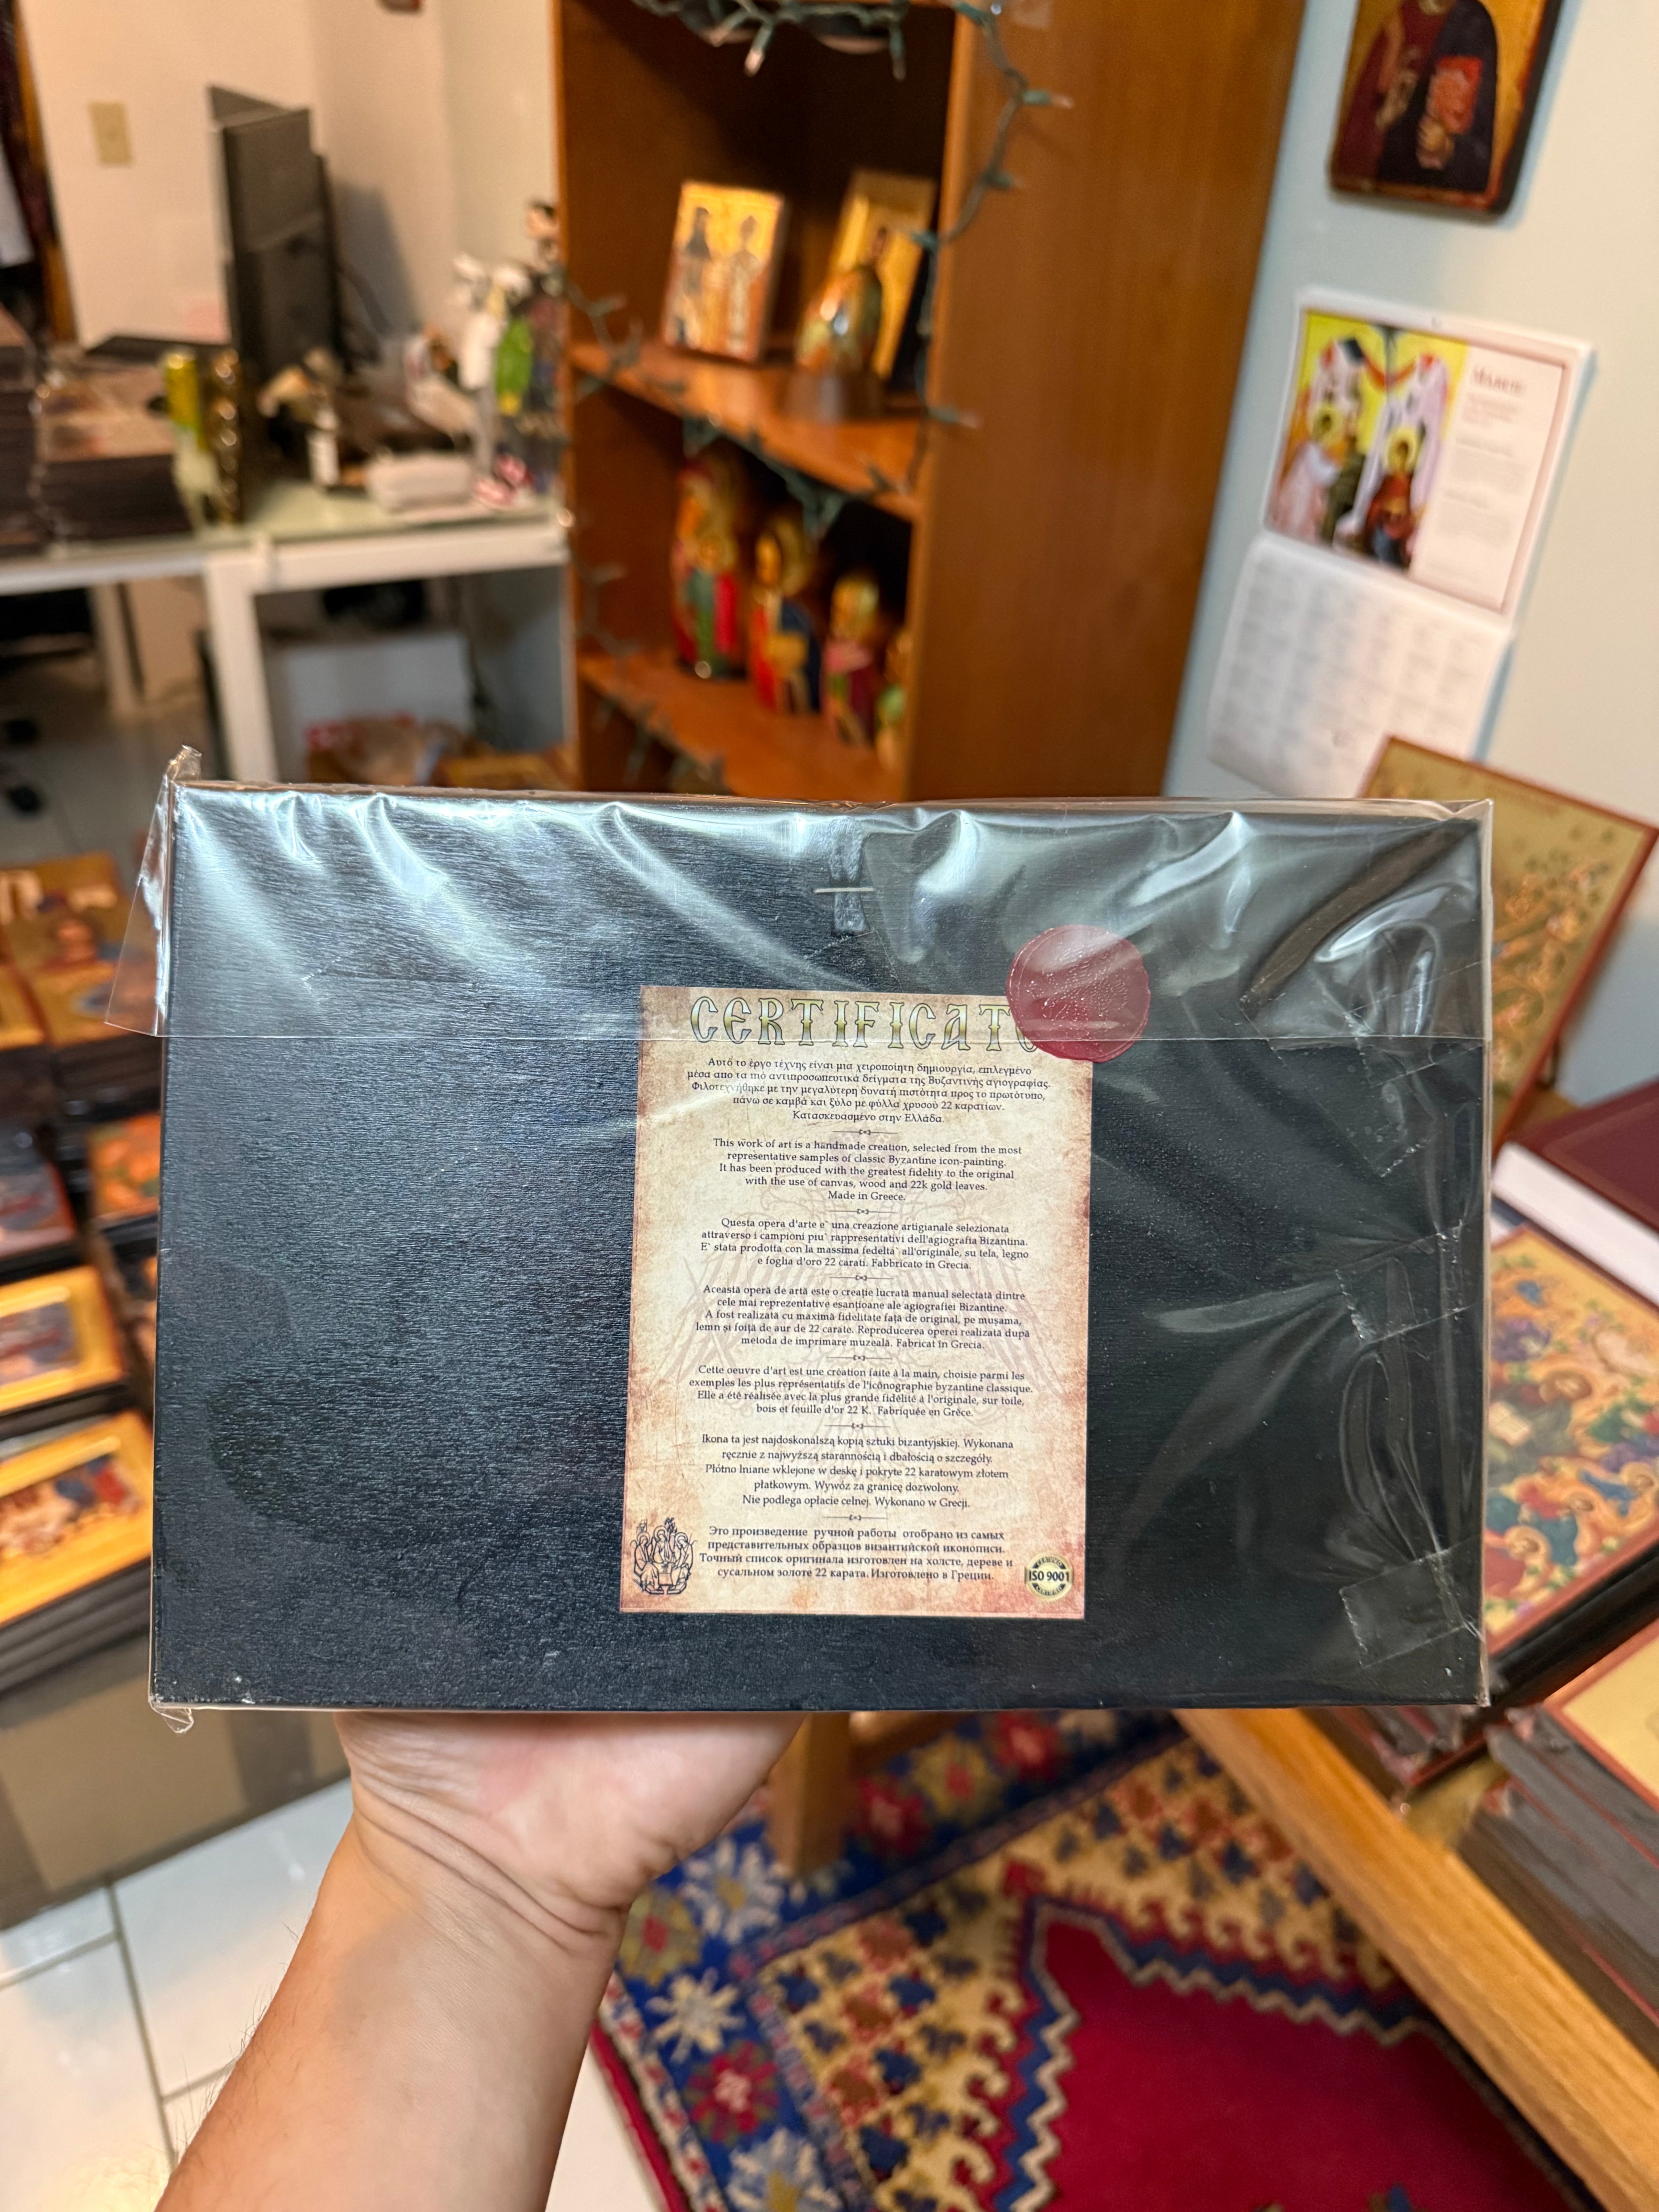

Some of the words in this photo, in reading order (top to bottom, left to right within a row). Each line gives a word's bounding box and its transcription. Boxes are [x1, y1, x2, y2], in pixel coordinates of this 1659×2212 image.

[690, 996, 1038, 1052] CERTIFICAT
[855, 1101, 867, 1109] με
[941, 1100, 952, 1109] 22
[954, 1100, 1005, 1113] καρατίων.
[878, 1115, 902, 1124] στην
[713, 1137, 734, 1147] This
[737, 1138, 763, 1147] work
[765, 1138, 775, 1148] of
[778, 1140, 792, 1148] art
[795, 1140, 803, 1149] is
[812, 1140, 865, 1150] handmade
[867, 1141, 910, 1153] creation,
[912, 1142, 951, 1152] selected
[954, 1144, 977, 1153] from
[980, 1144, 995, 1154] the
[998, 1146, 1022, 1154] most
[727, 1150, 797, 1163] representative
[799, 1152, 839, 1165] samples
[841, 1153, 852, 1163] of
[854, 1154, 885, 1163] classic
[888, 1154, 937, 1167] Byzantine
[939, 1156, 1007, 1169] icon-painting.
[719, 1162, 727, 1171] It
[730, 1162, 746, 1172] has
[749, 1163, 772, 1173] been
[775, 1163, 821, 1176] produced
[824, 1165, 849, 1174] with
[850, 1165, 865, 1175] the
[868, 1167, 906, 1179] greatest
[908, 1167, 943, 1179] fidelity
[945, 1169, 957, 1177] to
[959, 1168, 974, 1178] the
[976, 1169, 1015, 1181] original
[745, 1175, 767, 1185] with
[769, 1176, 786, 1185] the
[807, 1177, 818, 1186] of
[820, 1180, 856, 1189] canvas,
[859, 1178, 886, 1188] wood
[889, 1179, 908, 1189] and
[910, 1179, 928, 1189] 22k
[930, 1180, 953, 1192] gold
[955, 1180, 988, 1190] leaves.
[828, 1189, 855, 1199] Made
[858, 1191, 869, 1199] in
[871, 1191, 906, 1201] Greece.
[721, 1217, 755, 1230] Questa
[758, 1220, 785, 1230] opera
[788, 1218, 817, 1229] d'arte
[853, 1220, 899, 1230] creazione
[900, 1221, 953, 1234] artigianale
[956, 1222, 1009, 1233] selezionata
[766, 1255, 794, 1268] foglia
[796, 1256, 822, 1266] d'oro
[824, 1256, 836, 1266] 22
[839, 1257, 869, 1267] carati.
[871, 1258, 923, 1268] Fabbricato
[925, 1259, 935, 1268] in
[938, 1259, 972, 1269] Grecia.
[741, 1334, 777, 1345] metoda
[780, 1335, 792, 1345] de
[795, 1336, 848, 1349] imprimare
[896, 1338, 935, 1348] Fabricat
[950, 1338, 985, 1349] Grecia.
[698, 1364, 725, 1374] Cette
[763, 1365, 786, 1375] d'art
[788, 1367, 803, 1376] est
[868, 1367, 890, 1377] faite
[893, 1368, 898, 1378] à
[900, 1368, 912, 1378] la
[913, 1369, 941, 1380] main,
[943, 1369, 977, 1379] choisie
[980, 1370, 1009, 1382] parmi
[1011, 1370, 1025, 1380] les
[689, 1376, 735, 1389] exemples
[738, 1377, 751, 1387] les
[754, 1378, 775, 1390] plus
[778, 1378, 845, 1392] représentatifs
[846, 1379, 860, 1389] de
[935, 1381, 984, 1395] byzantine
[986, 1382, 1033, 1395] classique.
[701, 1433, 728, 1443] Ikona
[731, 1435, 740, 1443] ta
[743, 1434, 759, 1446] jest
[761, 1434, 835, 1448] najdoskonalszą
[837, 1436, 864, 1448] kopią
[865, 1436, 896, 1446] sztuki
[898, 1437, 960, 1450] bizantyjskiej.
[963, 1438, 1014, 1451] Wykonana
[721, 1449, 757, 1461] ręcznie
[768, 1449, 819, 1462] najwyższą
[821, 1450, 881, 1464] starannością
[883, 1452, 887, 1461] i
[889, 1451, 935, 1465] dbałością
[753, 1479, 811, 1492] płatkowym.
[814, 1480, 851, 1493] Wywóz
[867, 1481, 903, 1494] granicę
[905, 1482, 960, 1495] dozwolony.
[742, 1494, 760, 1504] Nie
[763, 1494, 801, 1507] podlega
[804, 1494, 839, 1508] opłacie
[841, 1495, 871, 1508] celnej.
[874, 1496, 925, 1509] Wykonano
[939, 1497, 971, 1510] Grecji.
[709, 1525, 729, 1535] Это
[732, 1529, 808, 1539] произведение
[814, 1527, 854, 1540] ручной
[857, 1528, 899, 1541] работы
[903, 1528, 953, 1541] отобрано
[708, 1541, 809, 1553] представительных
[812, 1540, 862, 1554] образцов
[864, 1541, 940, 1552] византийской
[718, 1568, 774, 1580] сусальном
[815, 1567, 827, 1577] 22
[830, 1570, 869, 1581] карата.
[871, 1568, 939, 1579] Изготовлено
[951, 1569, 995, 1583] Греции.
[1029, 1570, 1044, 1581] ISO
[1046, 1571, 1069, 1581] 9001
